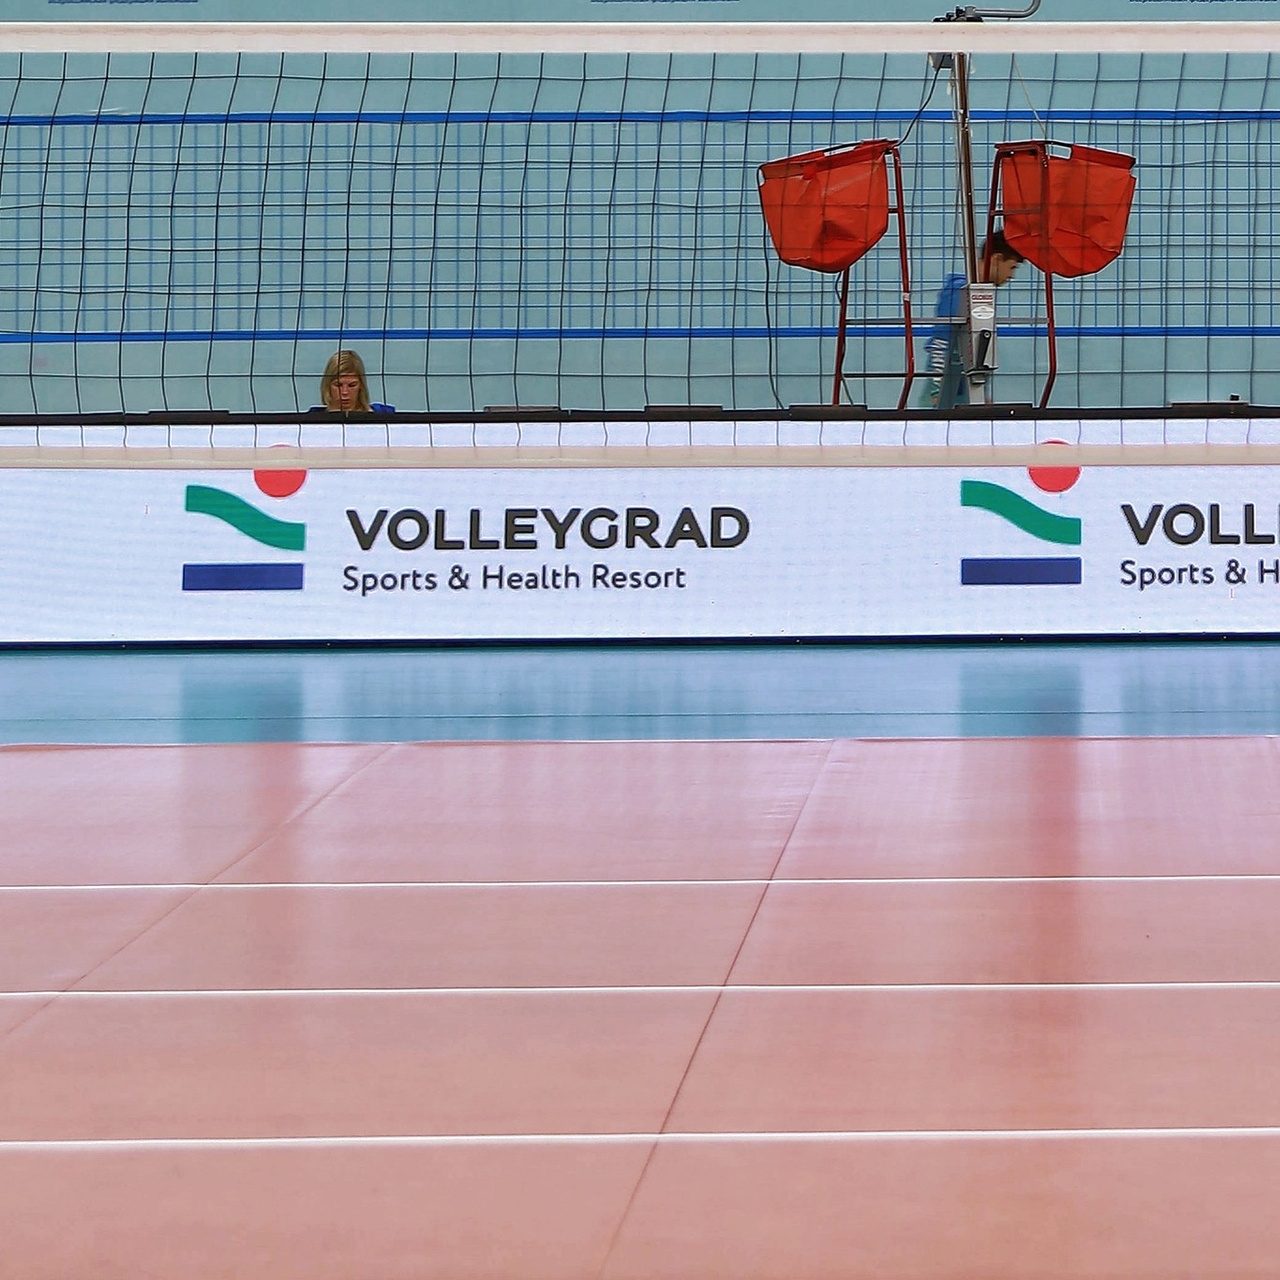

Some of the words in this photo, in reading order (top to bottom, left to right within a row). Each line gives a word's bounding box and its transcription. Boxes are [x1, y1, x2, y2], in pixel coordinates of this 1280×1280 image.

[346, 507, 749, 550] VOLLEYGRAD
[343, 565, 437, 596] Sports
[448, 565, 469, 590] &
[483, 565, 579, 589] Health
[593, 564, 686, 588] Resort
[1120, 559, 1214, 591] Sports
[1226, 559, 1247, 584] &
